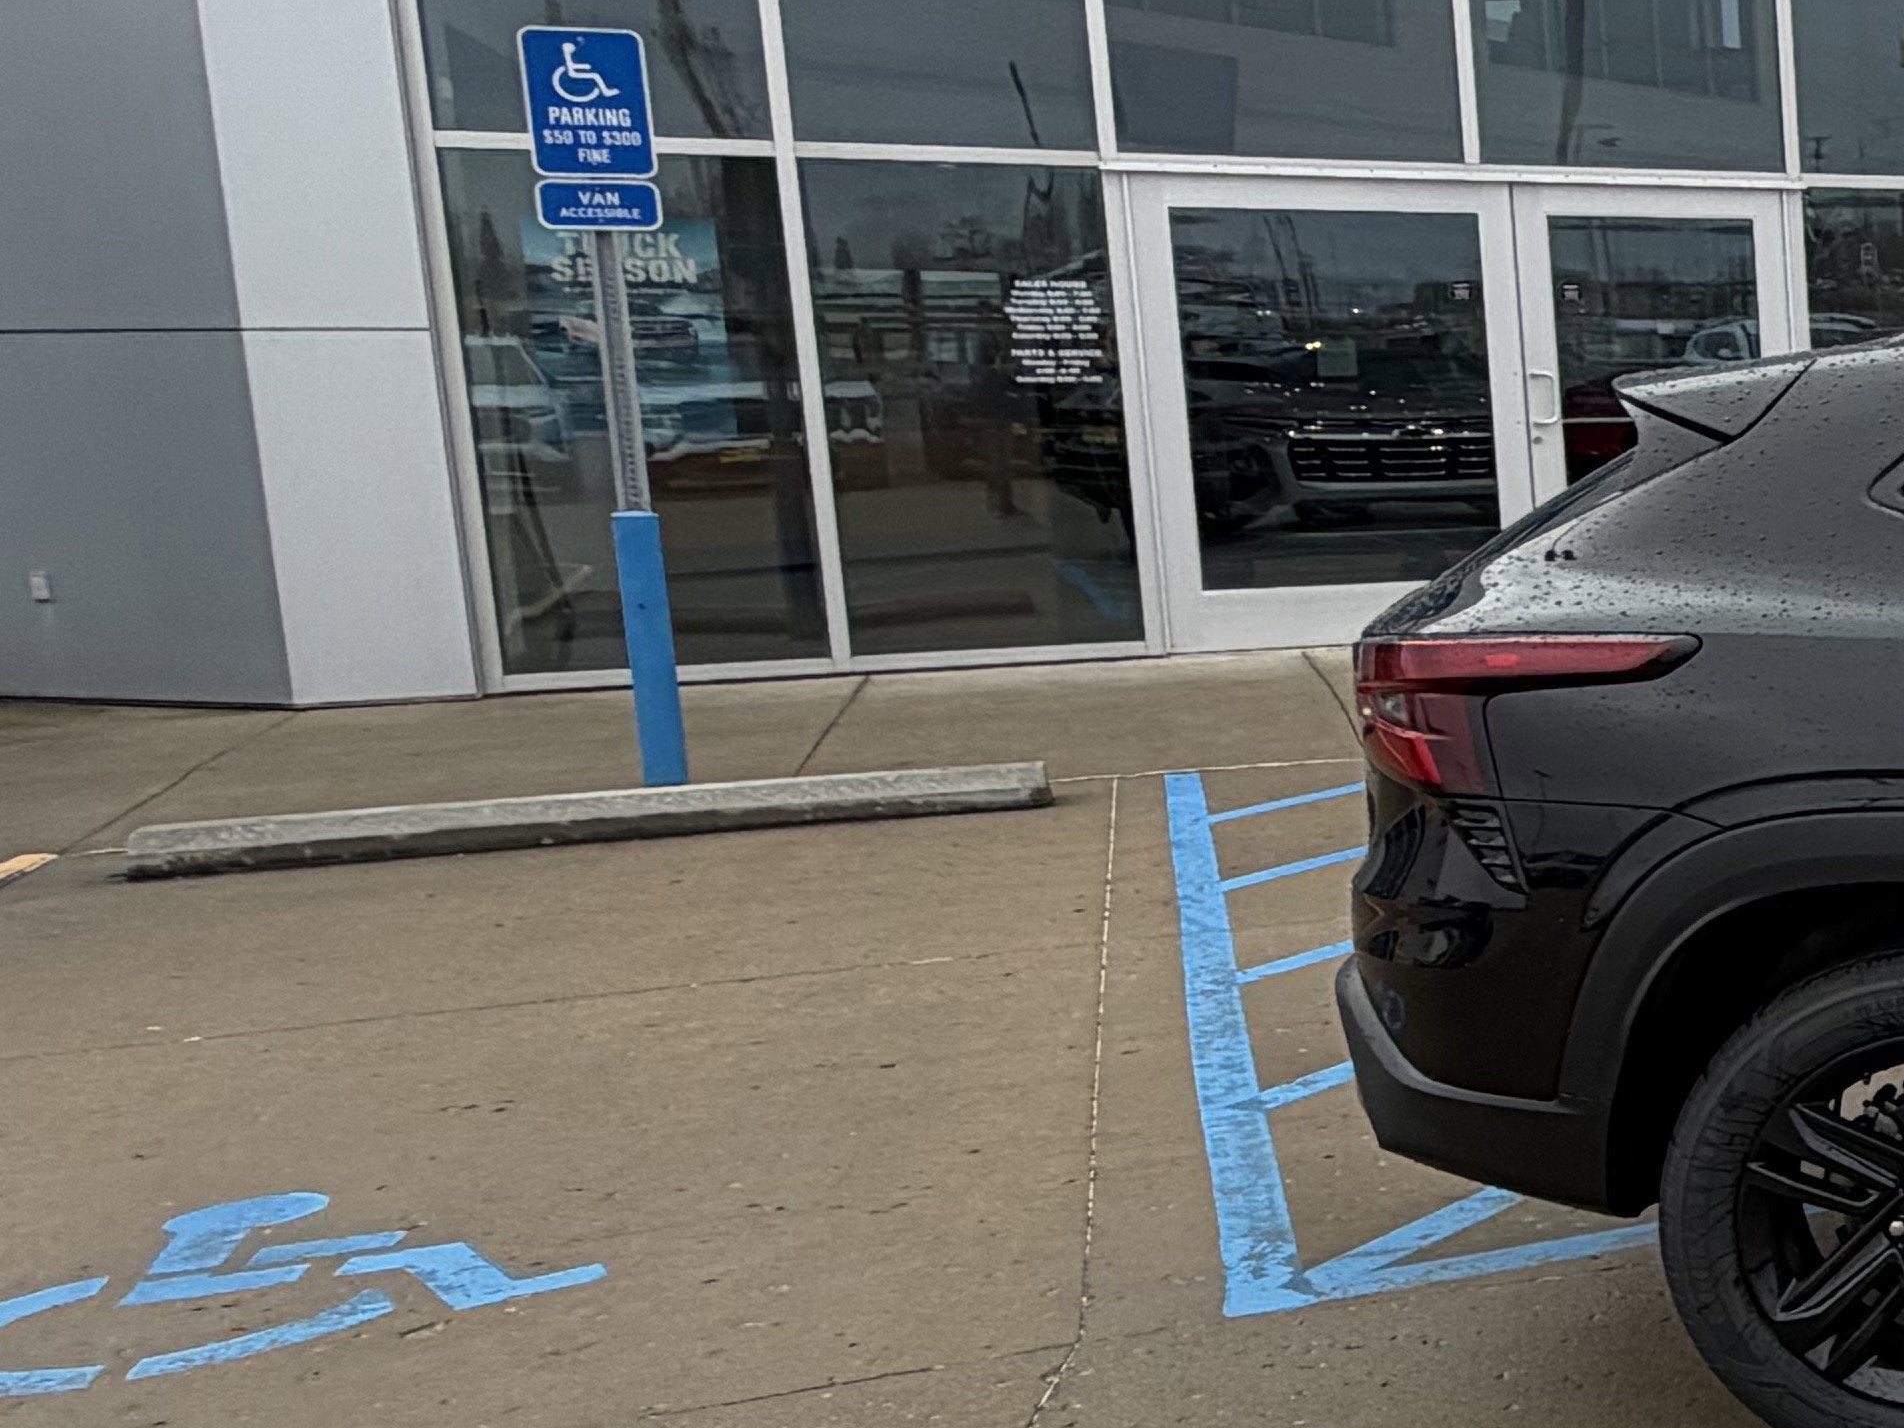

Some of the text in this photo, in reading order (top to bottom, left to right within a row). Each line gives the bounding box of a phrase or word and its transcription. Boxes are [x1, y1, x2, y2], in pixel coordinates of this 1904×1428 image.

[547, 106, 632, 127] PARKING
[542, 129, 642, 146] $50 TO $300
[577, 148, 612, 164] FINE
[578, 190, 620, 205] VAN
[559, 208, 642, 220] ACCESSIBLE
[556, 232, 682, 258] TCK
[551, 257, 698, 284] SESON
